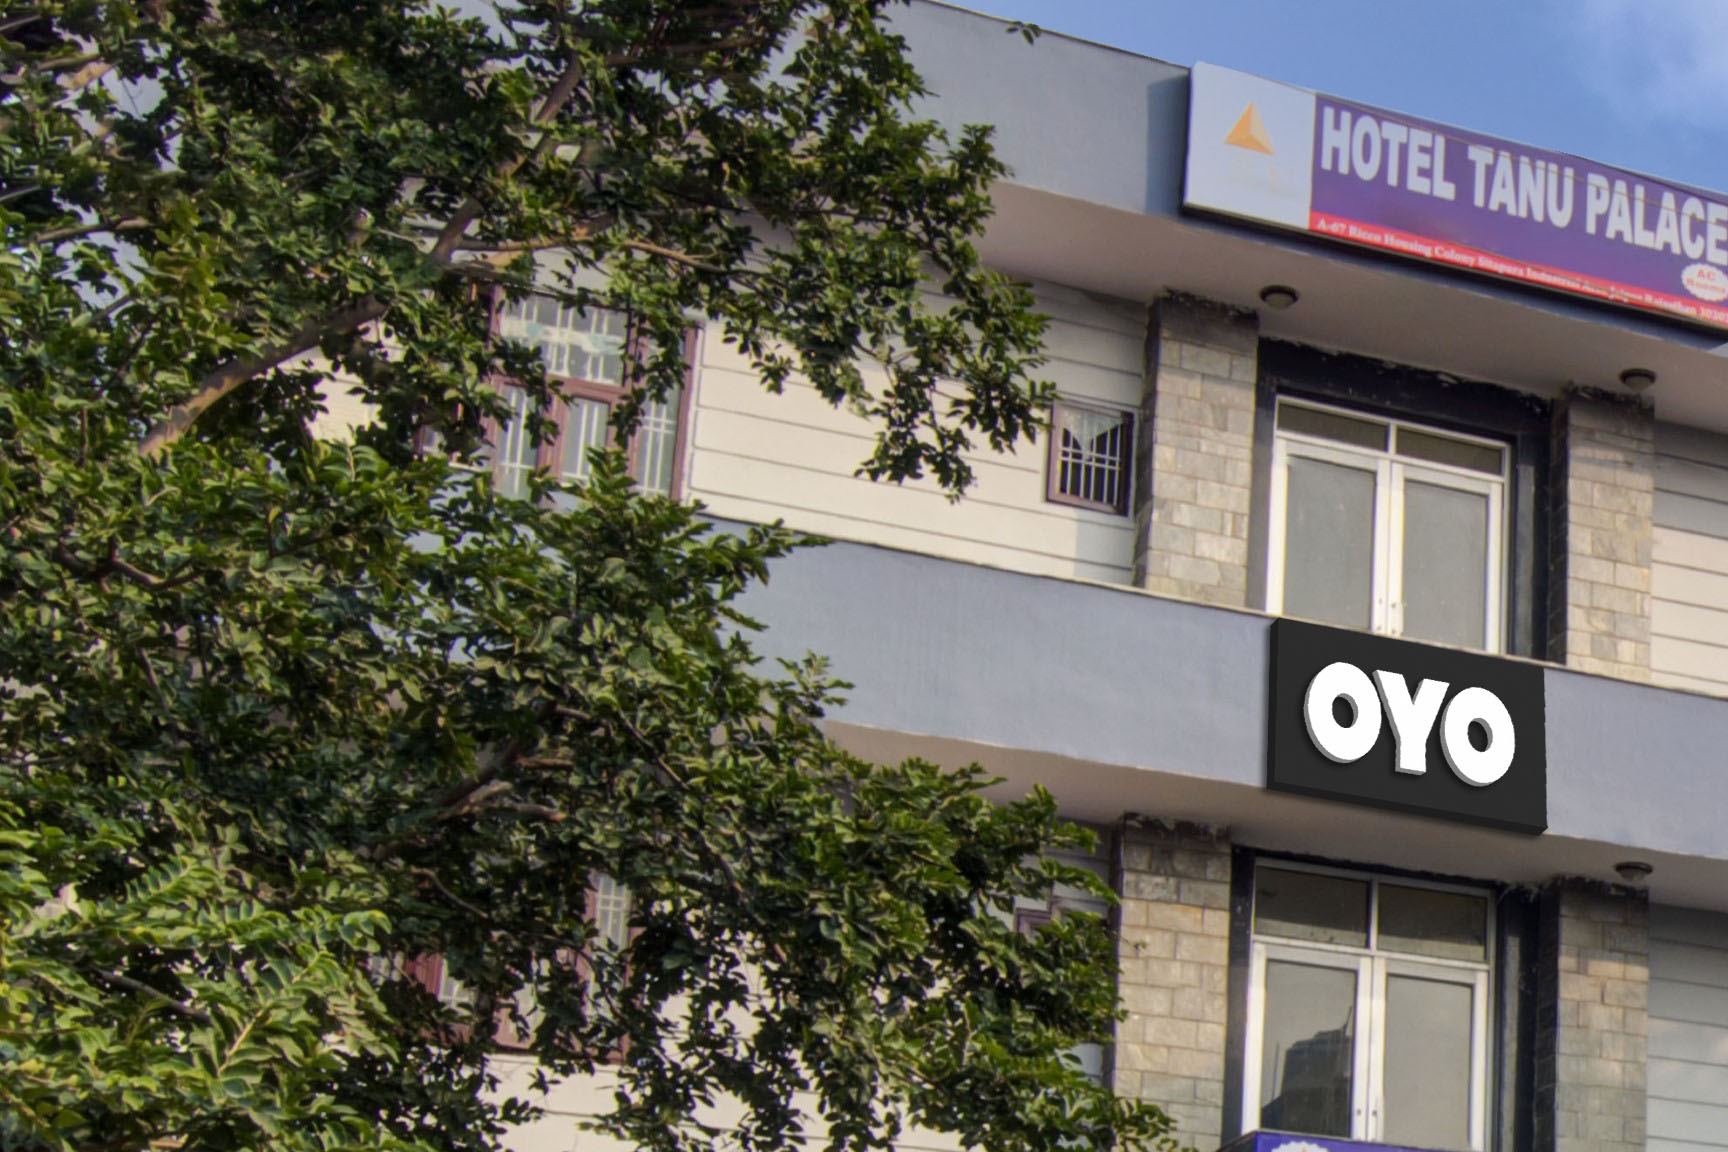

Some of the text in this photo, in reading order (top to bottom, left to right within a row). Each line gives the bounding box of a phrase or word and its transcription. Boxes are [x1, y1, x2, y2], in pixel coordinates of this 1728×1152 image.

[1320, 106, 1728, 266] HOTEL TANU PALACE
[1384, 233, 1431, 257] Housing
[1434, 246, 1475, 267] Colony
[1303, 661, 1515, 787] OYO
